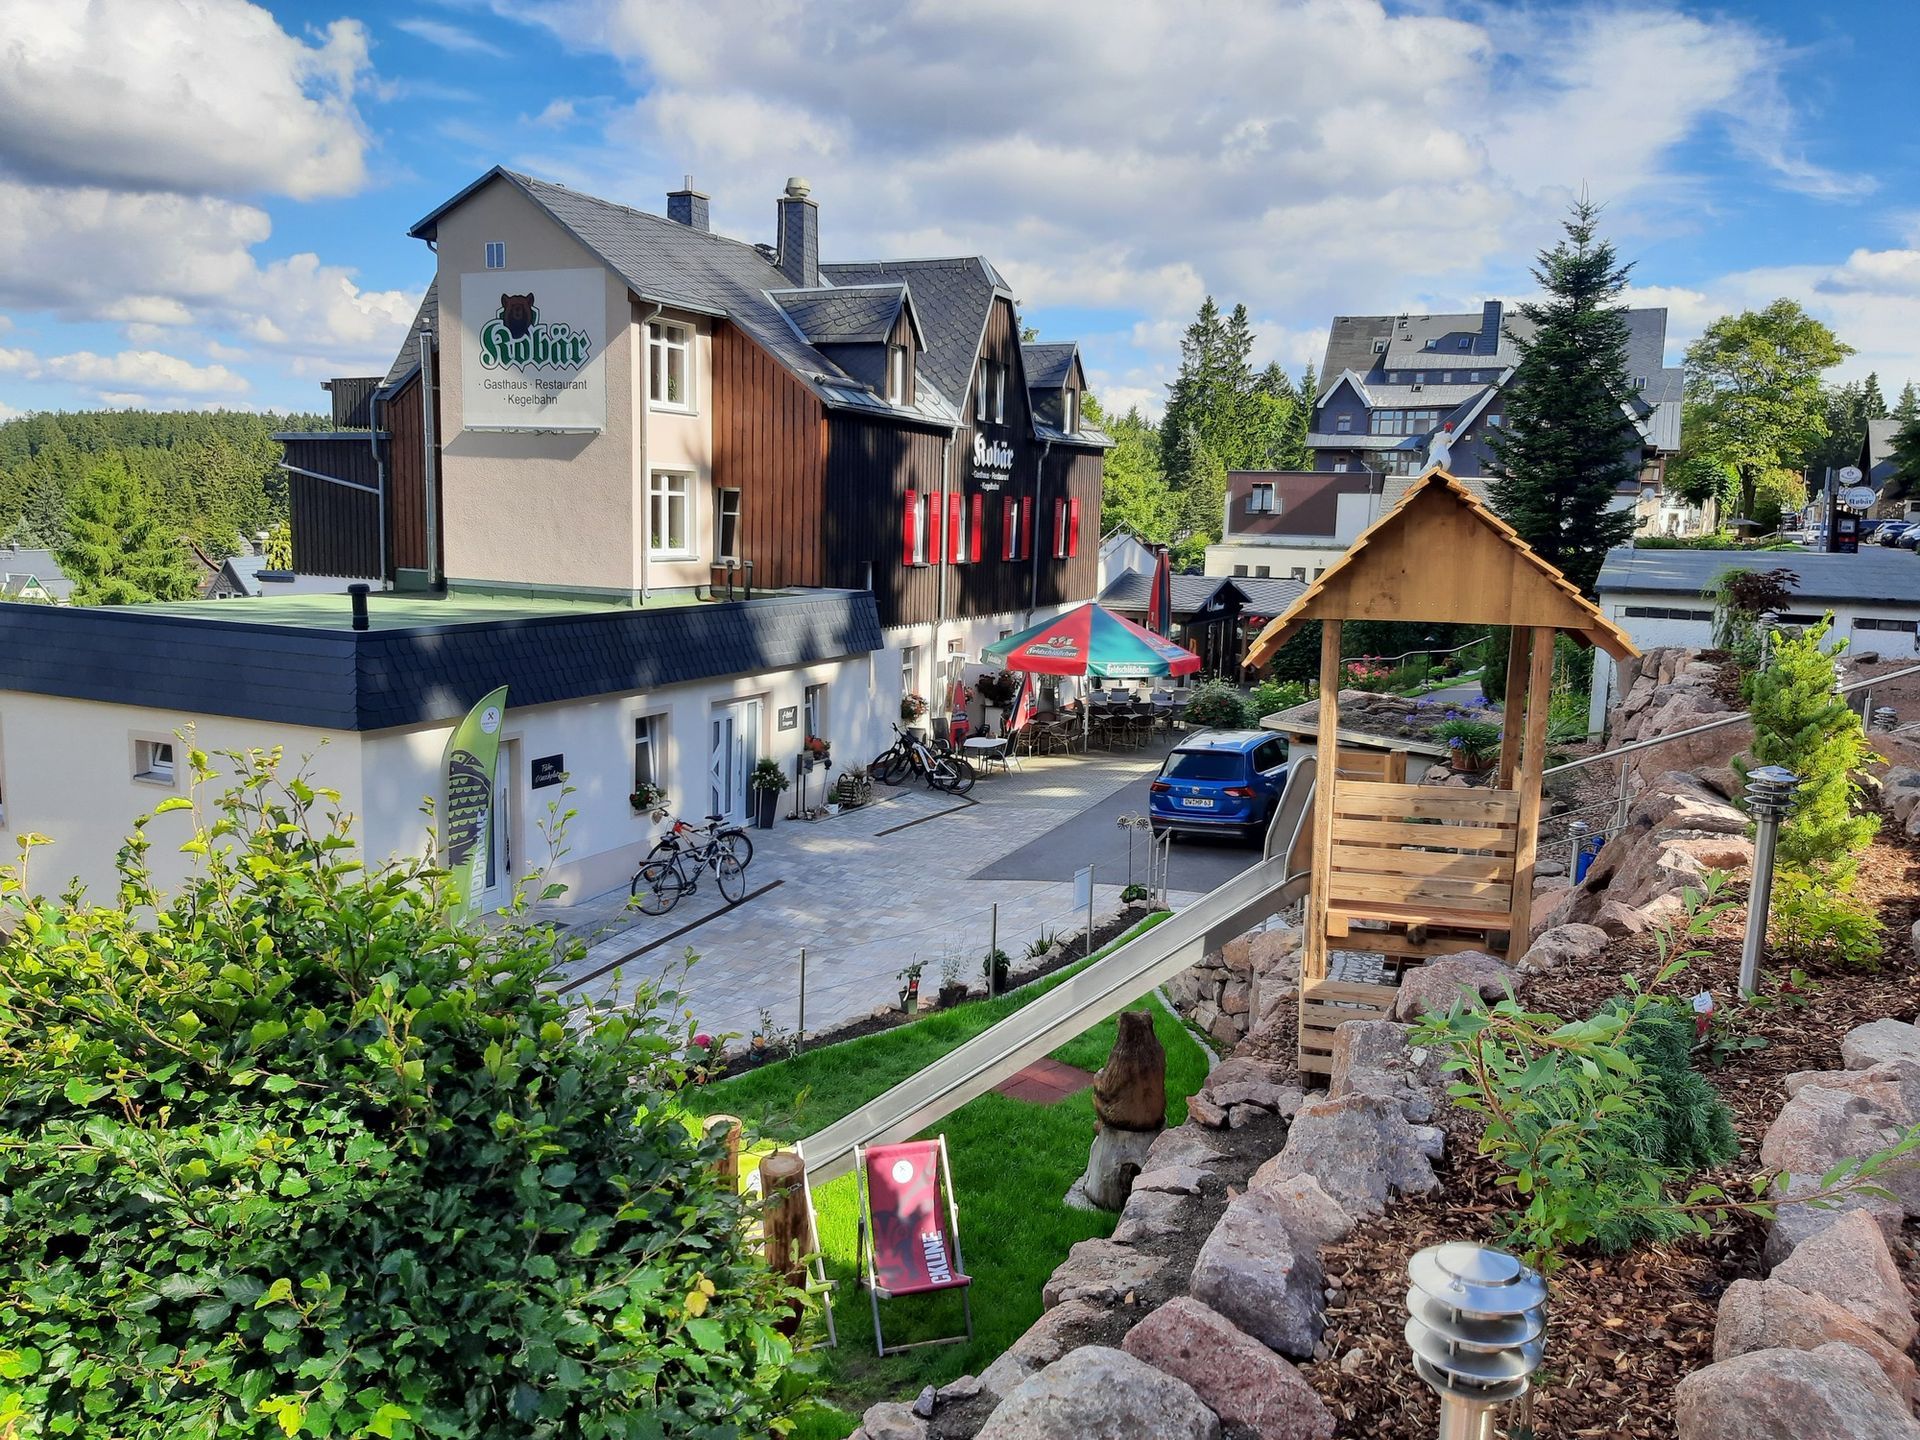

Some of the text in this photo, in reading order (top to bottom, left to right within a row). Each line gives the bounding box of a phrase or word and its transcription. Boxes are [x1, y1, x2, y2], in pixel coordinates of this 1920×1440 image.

[481, 323, 588, 367] Kobär
[484, 379, 587, 390] Gasthaus Restaurant
[508, 394, 557, 407] Kegelbahn
[973, 432, 1014, 470] Kobär
[921, 1230, 952, 1284] CKLINE
